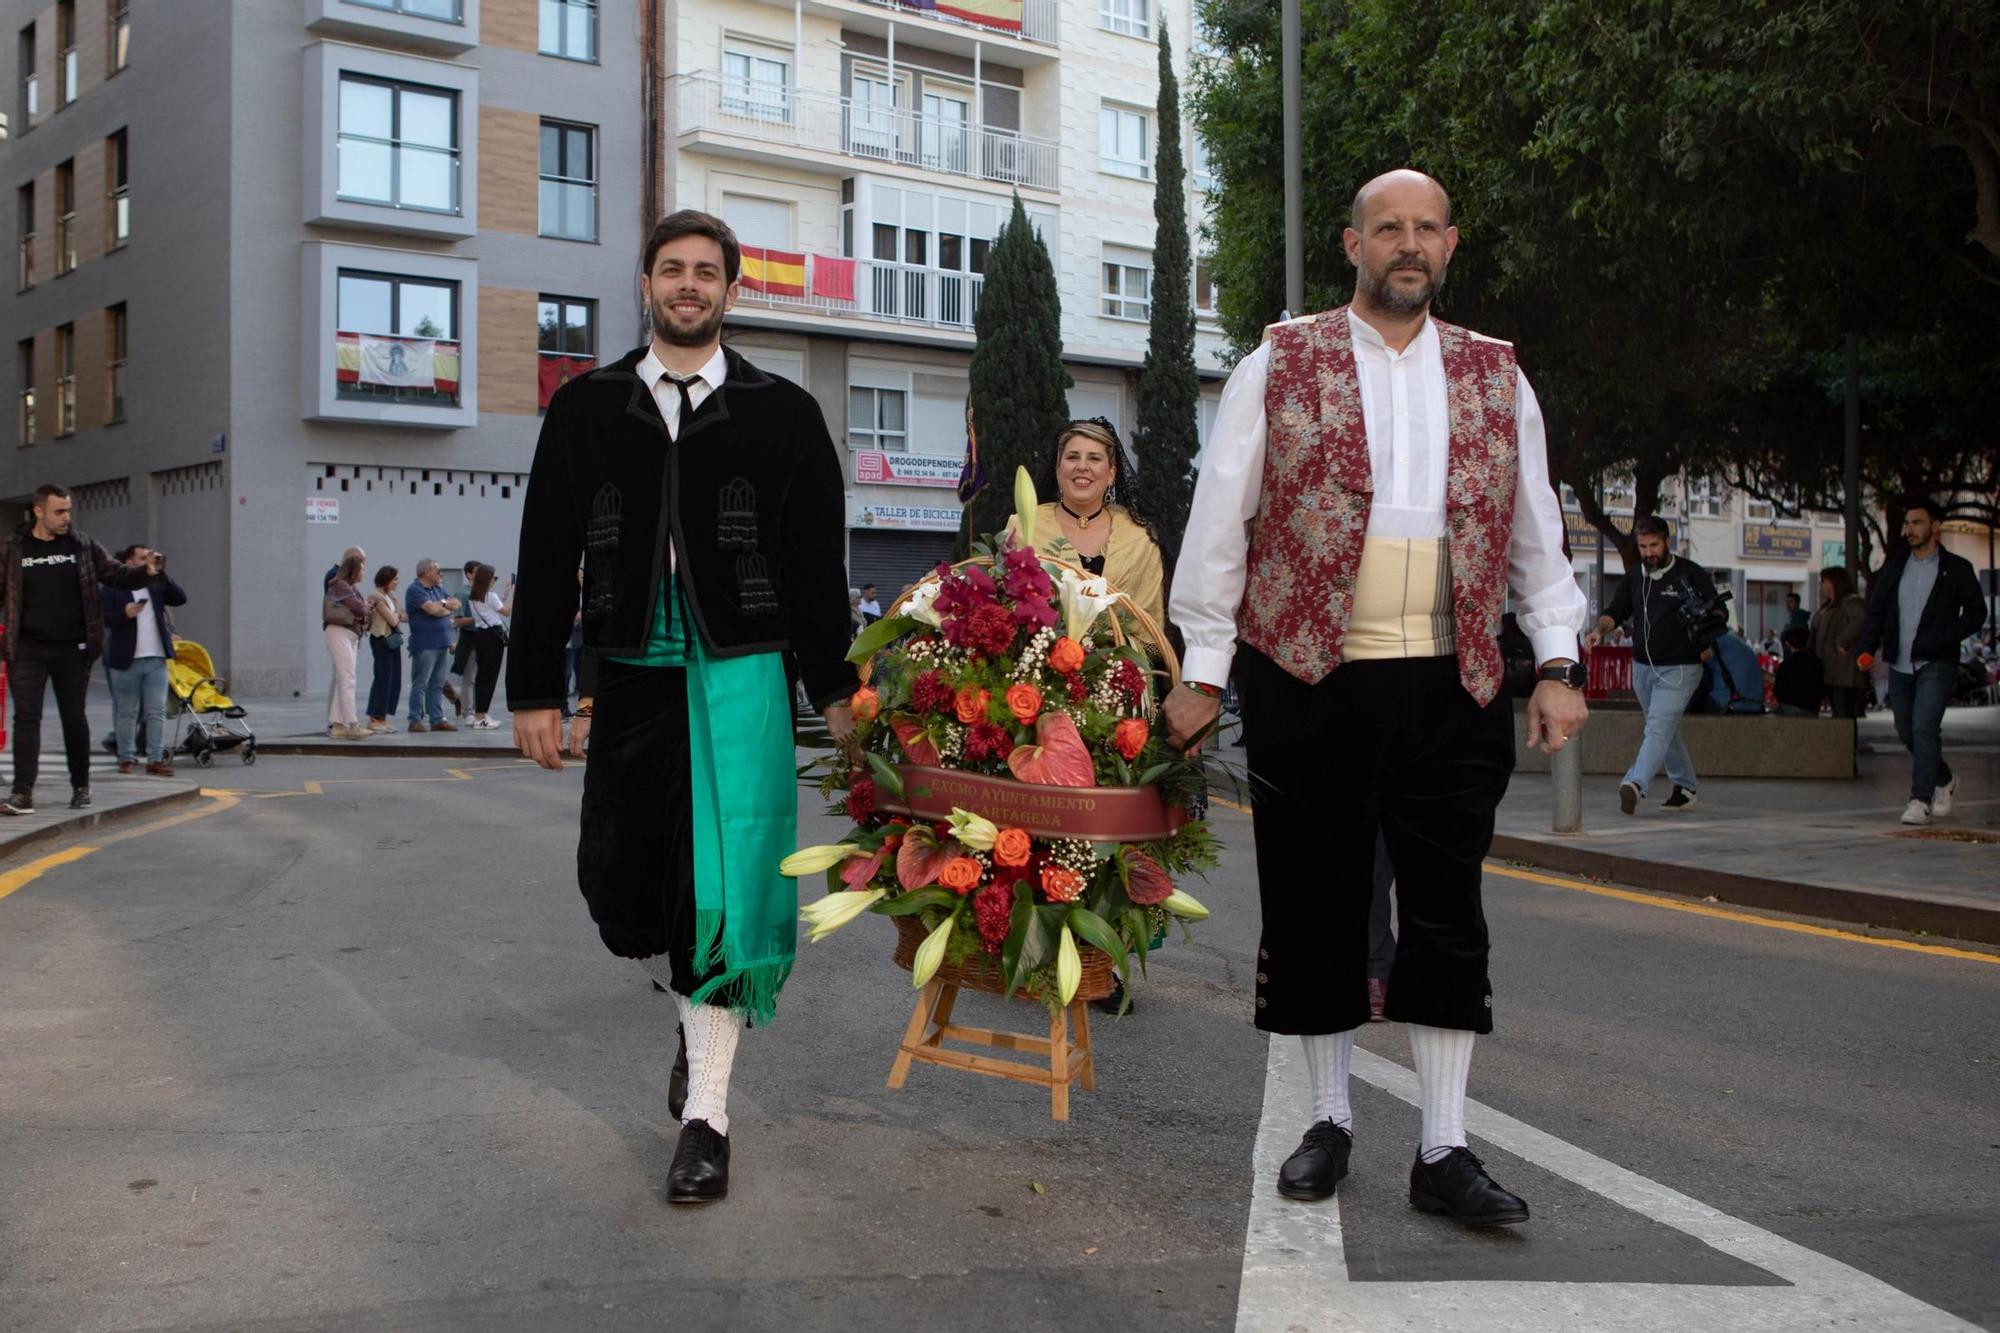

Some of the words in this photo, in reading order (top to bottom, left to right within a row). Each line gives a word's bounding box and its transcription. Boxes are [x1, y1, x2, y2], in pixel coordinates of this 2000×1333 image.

[859, 471, 881, 481] apad
[875, 507, 907, 517] TALLER
[909, 509, 920, 518] DE
[923, 509, 961, 520] BICICLET
[931, 780, 977, 798] EXCMO
[980, 788, 1096, 812] AYUNTAMIENTO
[969, 803, 1062, 827] CARTAGENA
